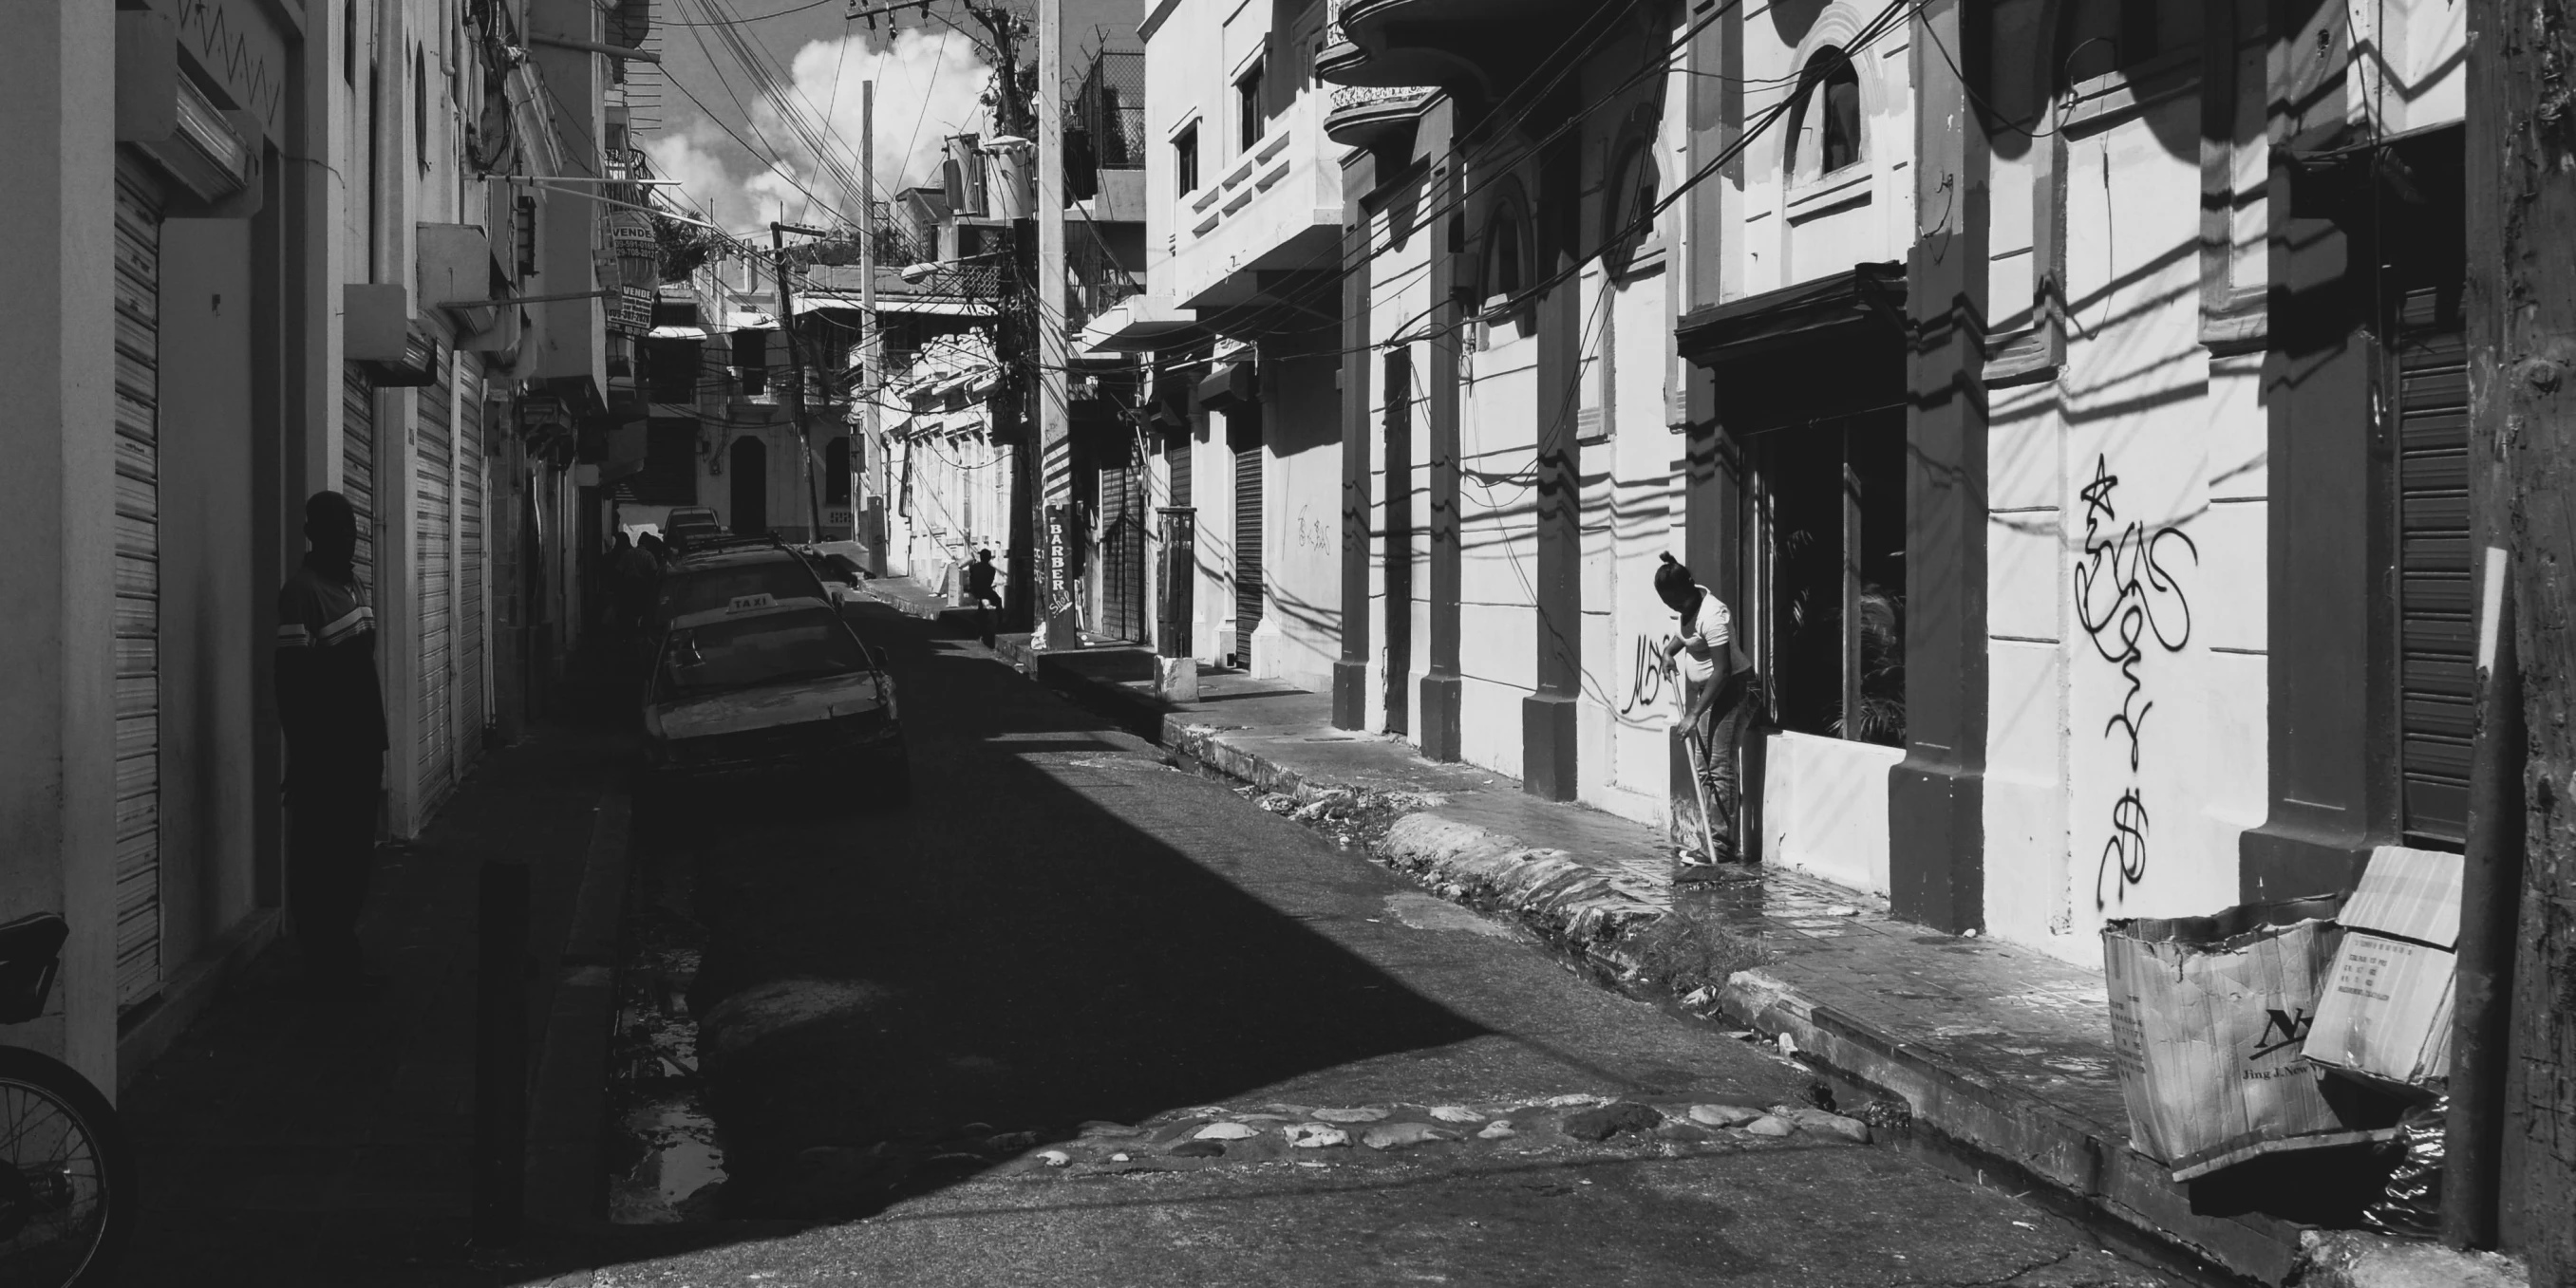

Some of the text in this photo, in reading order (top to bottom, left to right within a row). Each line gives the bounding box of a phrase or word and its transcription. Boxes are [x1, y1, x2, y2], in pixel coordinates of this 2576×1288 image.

[612, 228, 653, 238] VENDE
[623, 286, 651, 300] VENDE
[1050, 524, 1064, 590] BARBER
[734, 597, 766, 607] TAXI
[2243, 1069, 2271, 1081] Jing
